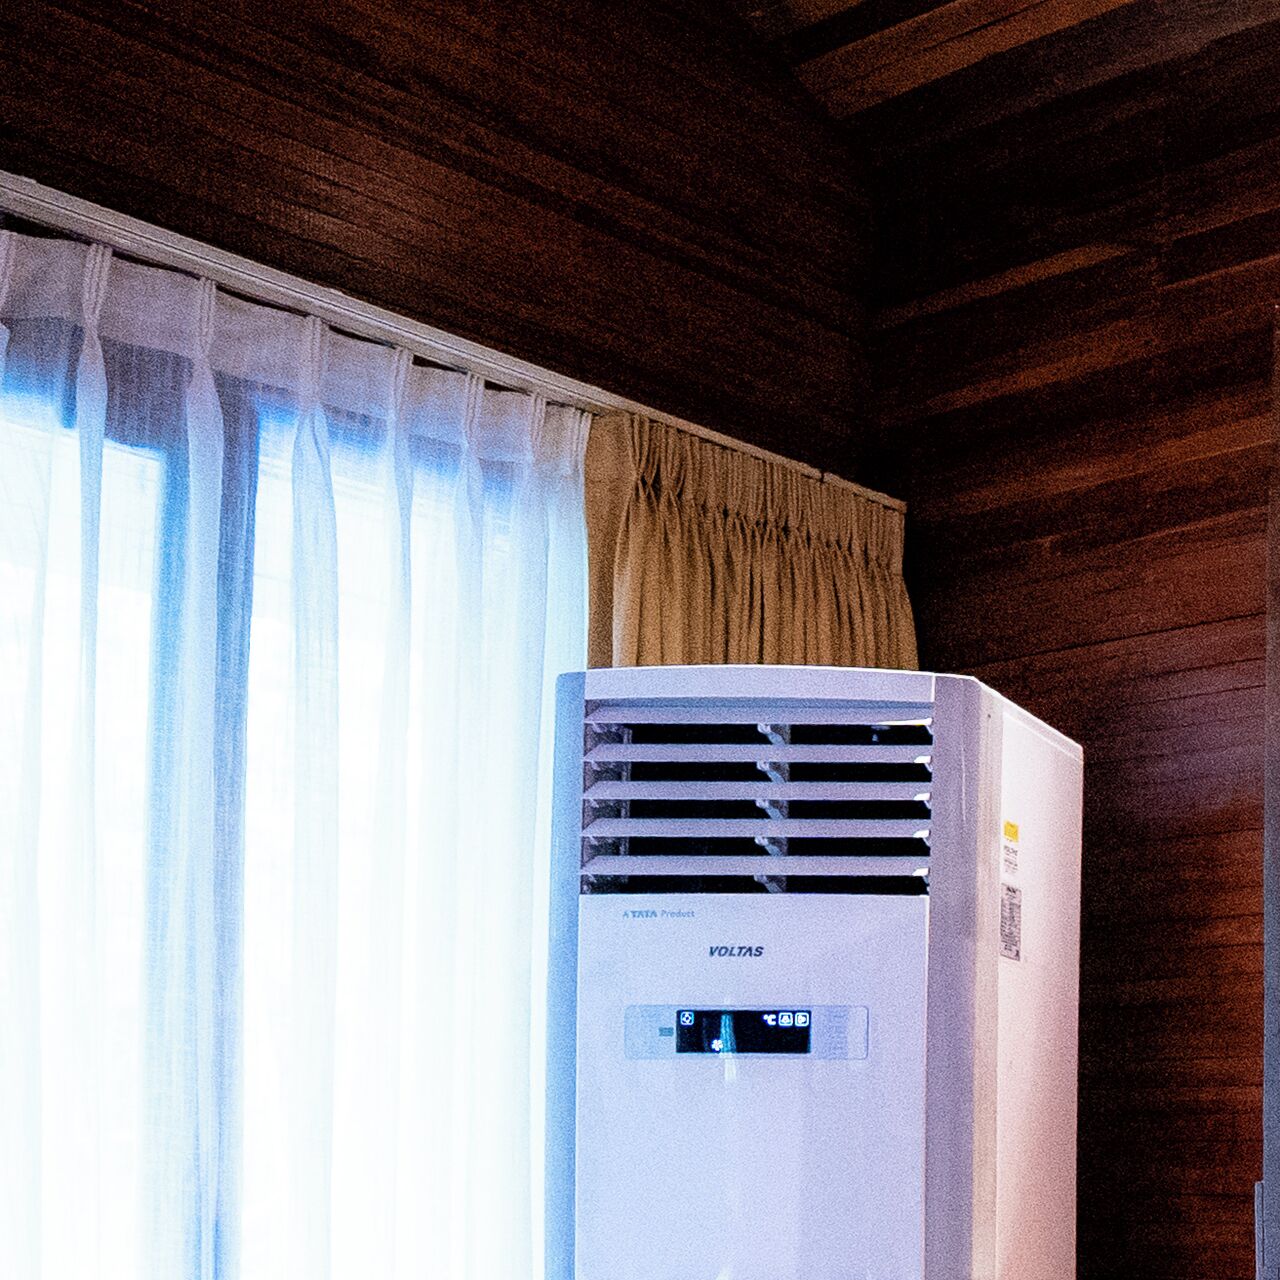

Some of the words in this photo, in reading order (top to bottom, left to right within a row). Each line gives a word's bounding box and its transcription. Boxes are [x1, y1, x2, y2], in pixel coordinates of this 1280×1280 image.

[631, 910, 657, 918] TATA
[660, 909, 695, 918] Product
[708, 945, 764, 958] VOLTAS
